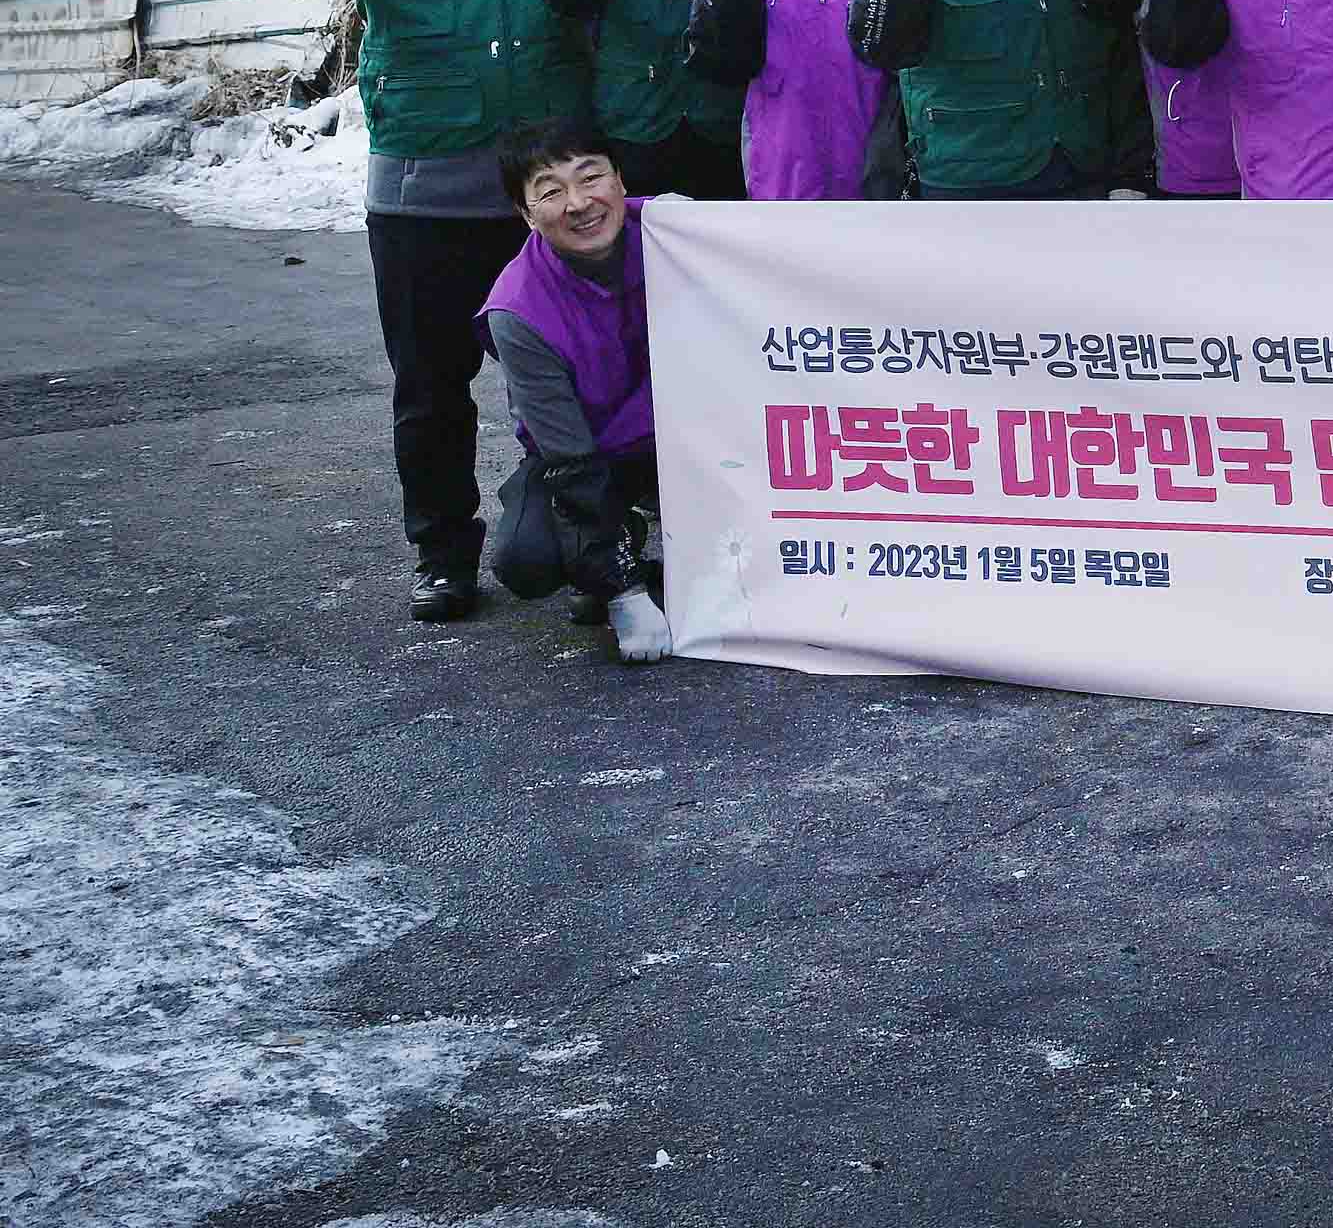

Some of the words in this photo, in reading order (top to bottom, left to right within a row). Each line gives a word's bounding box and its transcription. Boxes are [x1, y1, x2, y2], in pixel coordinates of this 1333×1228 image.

[762, 327, 1242, 382] 산업통상자원부·강원랜드와
[768, 404, 978, 493] 따뜻한
[999, 409, 1290, 504] 대한민국
[780, 540, 835, 575] 일시
[869, 544, 967, 580] 2023년
[978, 547, 1021, 582] 1월
[1031, 548, 1075, 584] 5일
[1084, 550, 1170, 587] 목요일
